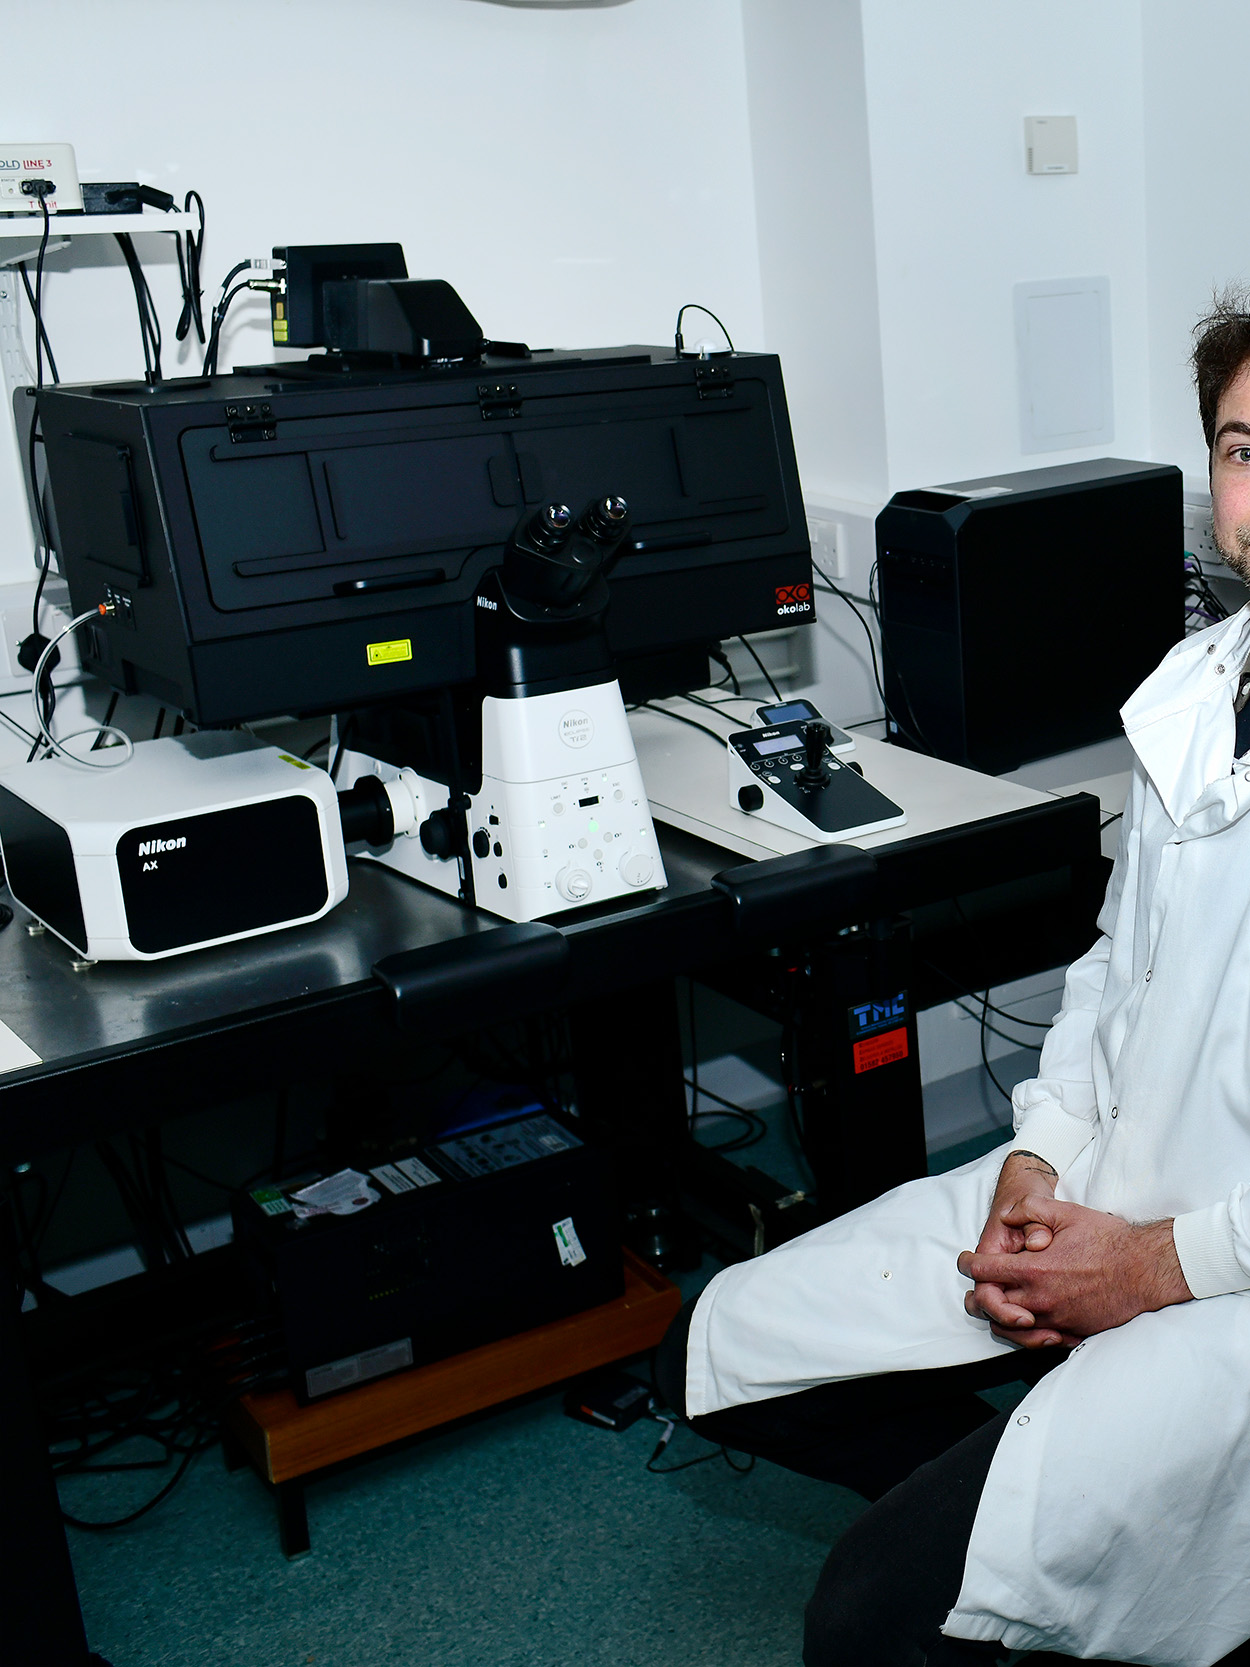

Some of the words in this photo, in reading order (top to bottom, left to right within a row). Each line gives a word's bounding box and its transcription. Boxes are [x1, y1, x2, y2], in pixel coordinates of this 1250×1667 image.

[23, 160, 45, 170] LINE
[477, 596, 497, 610] Nikon
[777, 602, 810, 615] okolab
[564, 718, 588, 728] Nikon
[138, 836, 186, 856] Nikon
[142, 860, 158, 872] AX
[854, 993, 904, 1026] TMC
